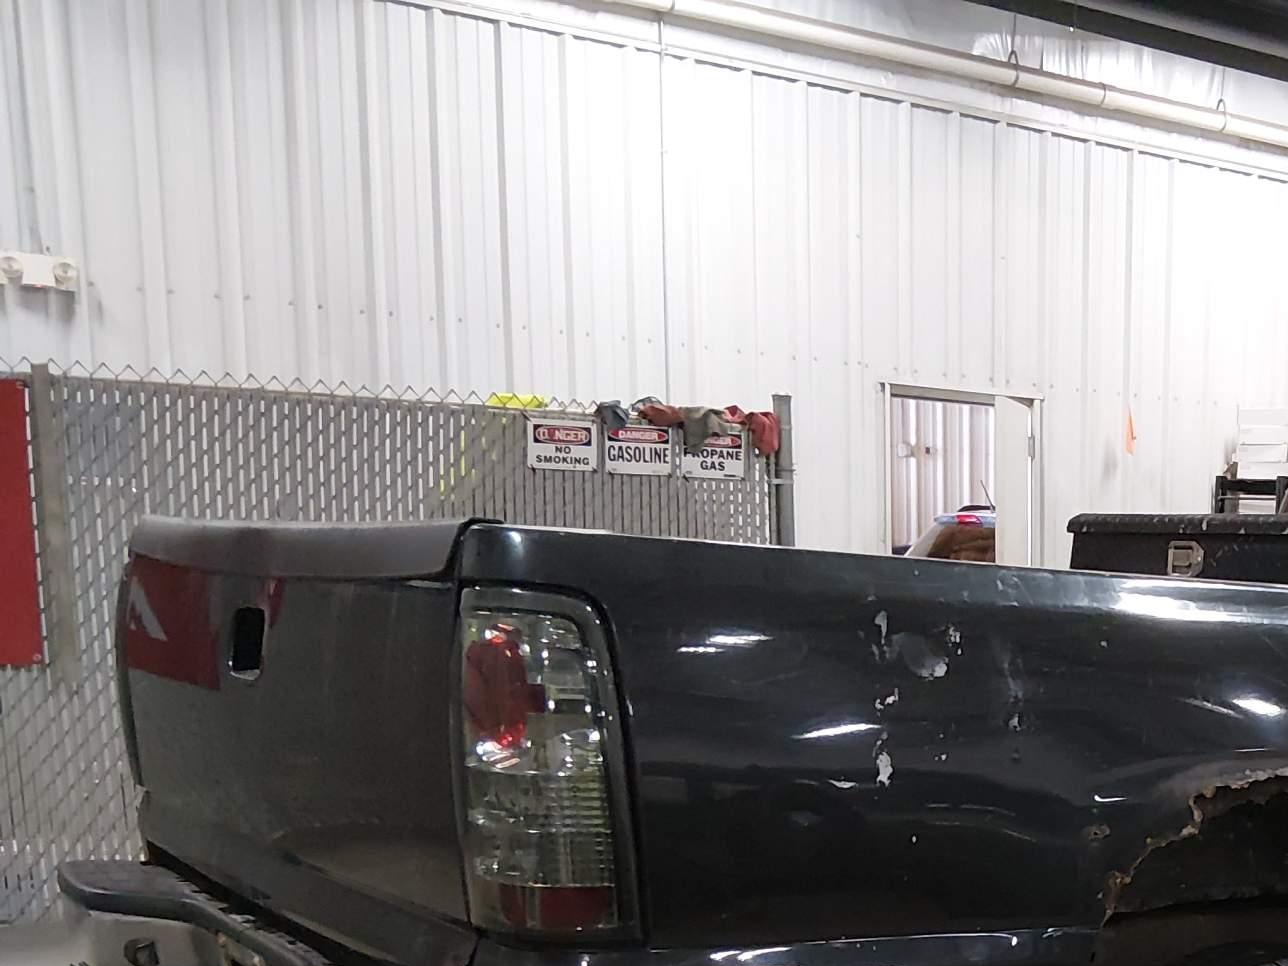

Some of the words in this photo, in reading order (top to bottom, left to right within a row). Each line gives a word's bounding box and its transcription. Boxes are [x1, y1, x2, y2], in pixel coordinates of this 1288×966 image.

[540, 428, 587, 441] DNGER
[555, 445, 572, 455] NO
[608, 445, 669, 464] GASOLINE
[536, 455, 590, 466] SMOKING
[700, 460, 725, 472] GAS
